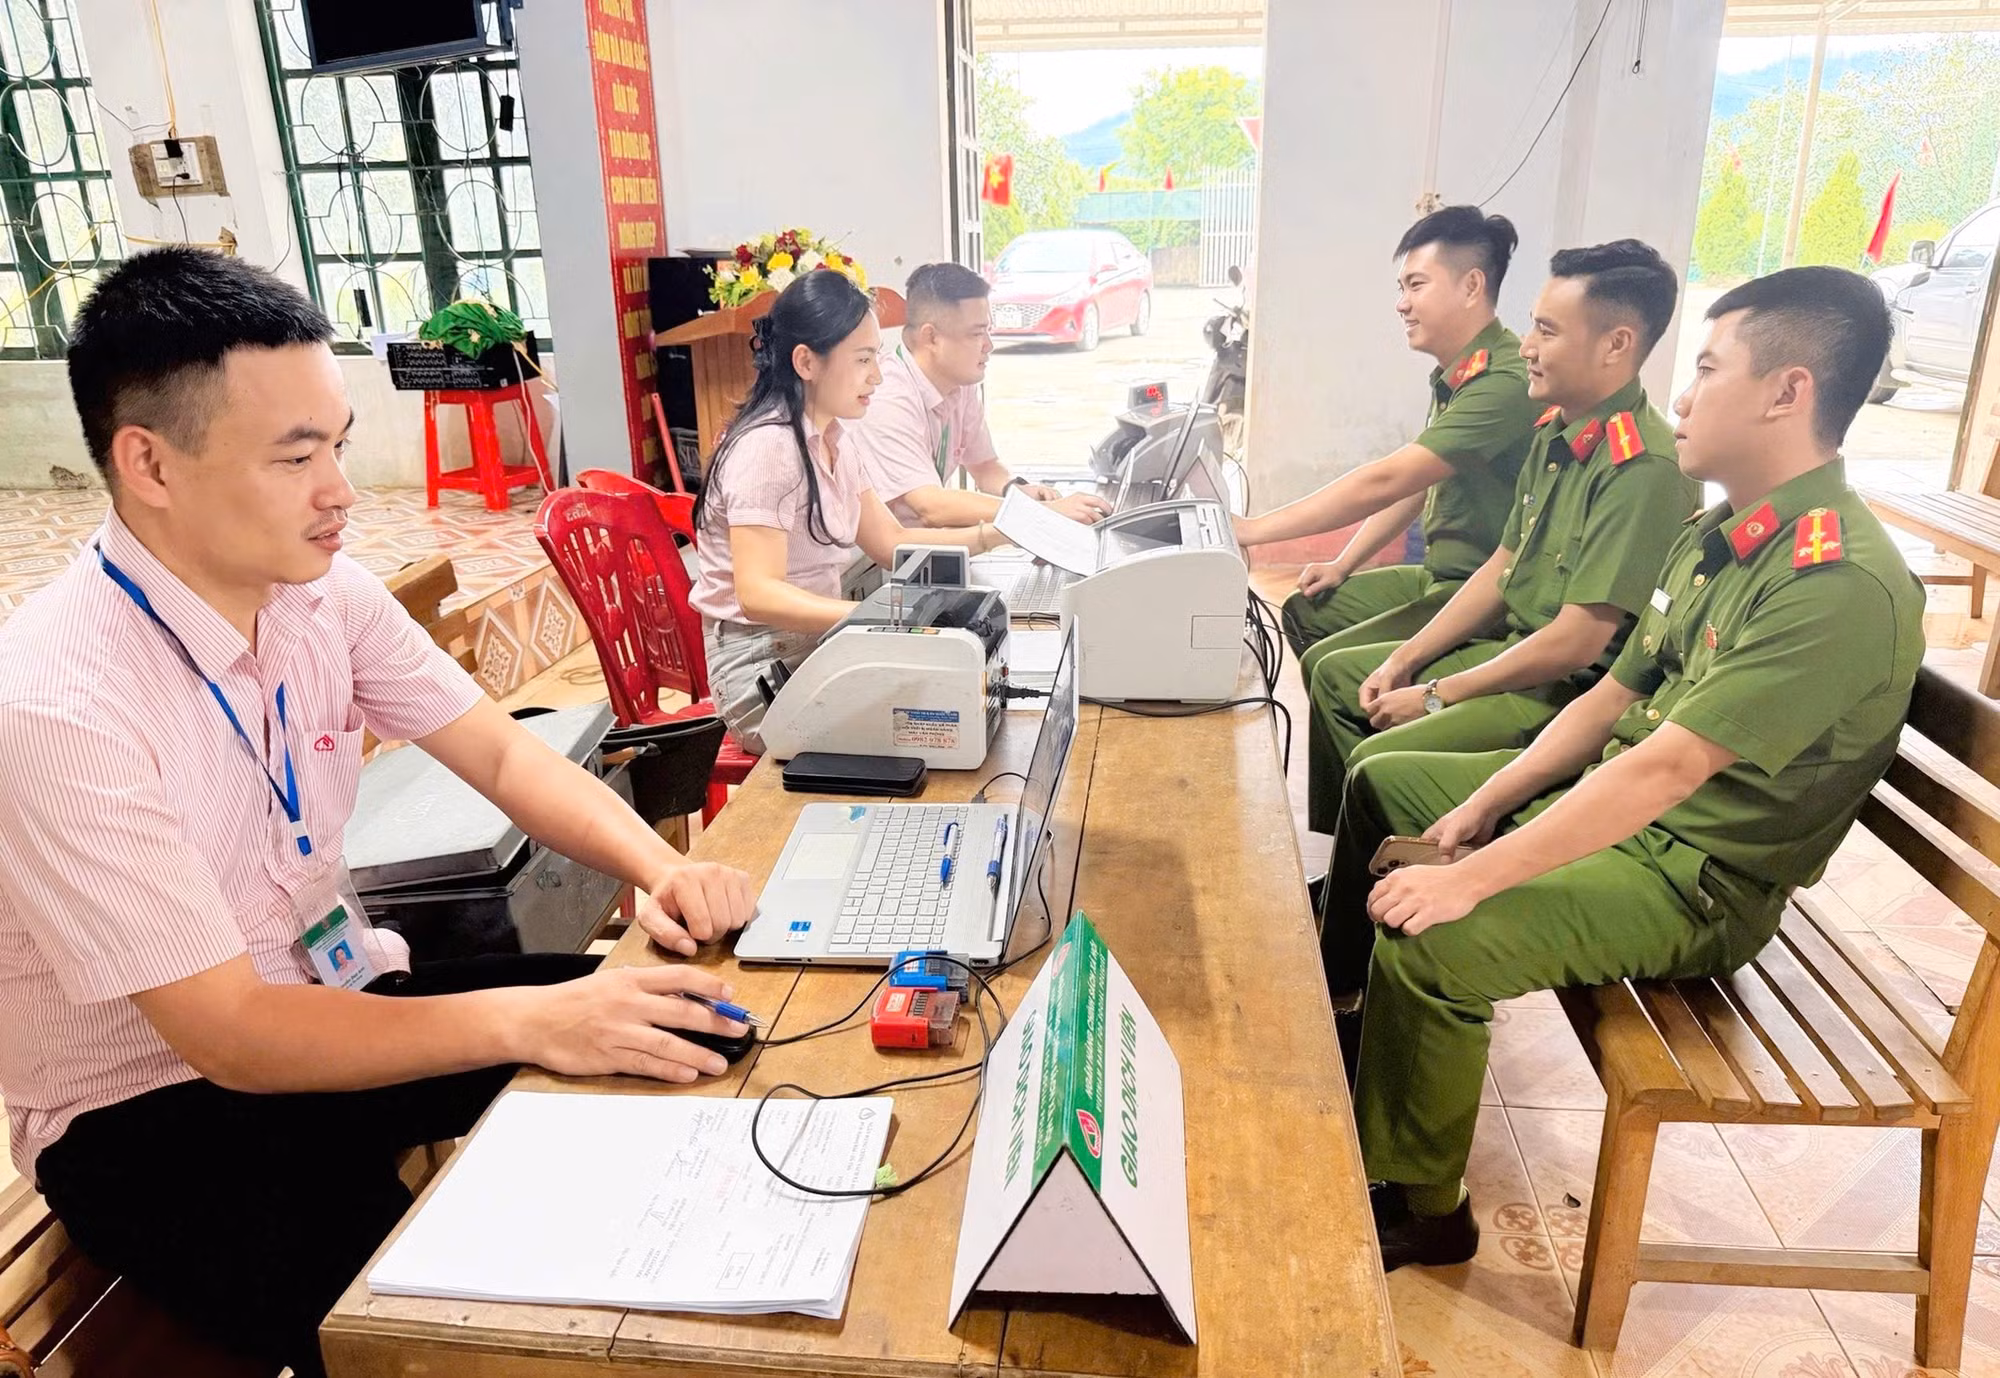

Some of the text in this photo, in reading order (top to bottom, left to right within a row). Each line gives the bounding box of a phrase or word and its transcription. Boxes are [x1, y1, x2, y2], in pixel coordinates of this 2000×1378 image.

[1018, 1010, 1036, 1070] GIAO
[1010, 1065, 1030, 1131] DỊCH
[1119, 1003, 1138, 1188] GIAO DỊCH VIÊN
